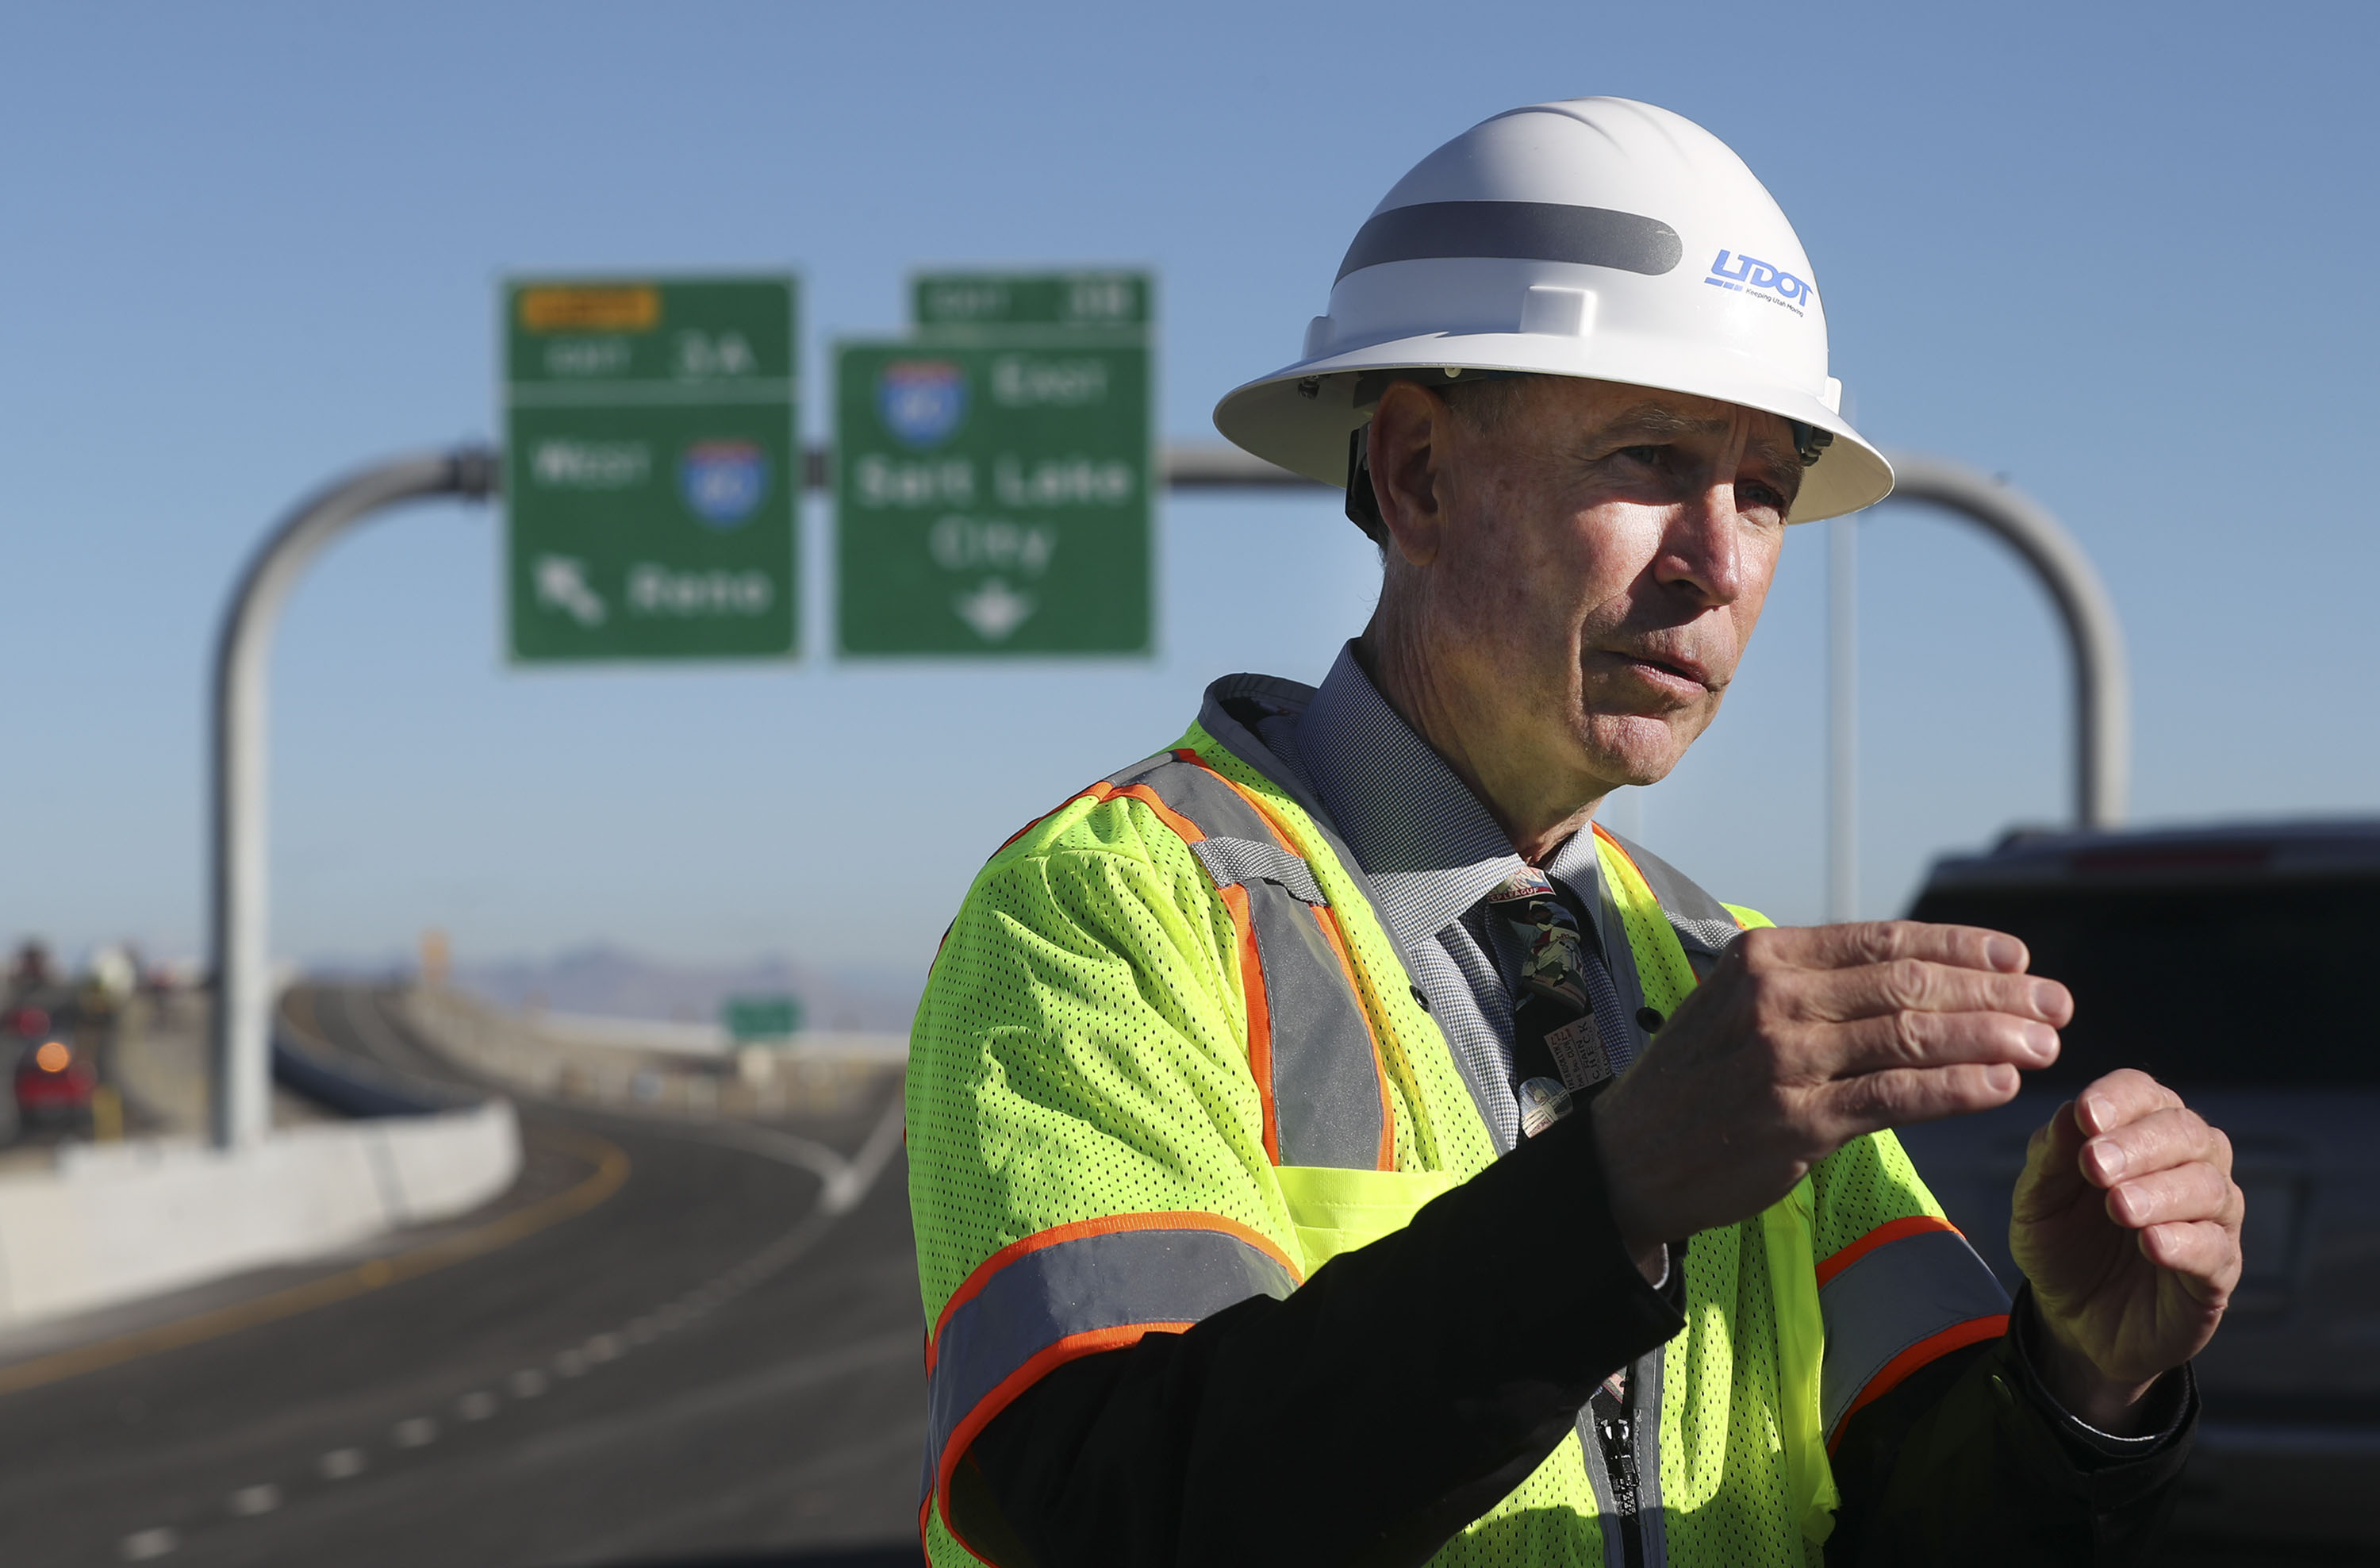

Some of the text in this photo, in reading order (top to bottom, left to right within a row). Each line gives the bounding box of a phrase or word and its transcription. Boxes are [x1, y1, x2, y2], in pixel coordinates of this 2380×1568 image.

[1745, 288, 1804, 317] Keeping Utah Moving
[857, 454, 1132, 509] Salt Lake
[929, 515, 1056, 578] City
[629, 561, 770, 615] Reno
[1576, 1040, 1590, 1068] RAIN
[1578, 1020, 1600, 1079] CHECK
